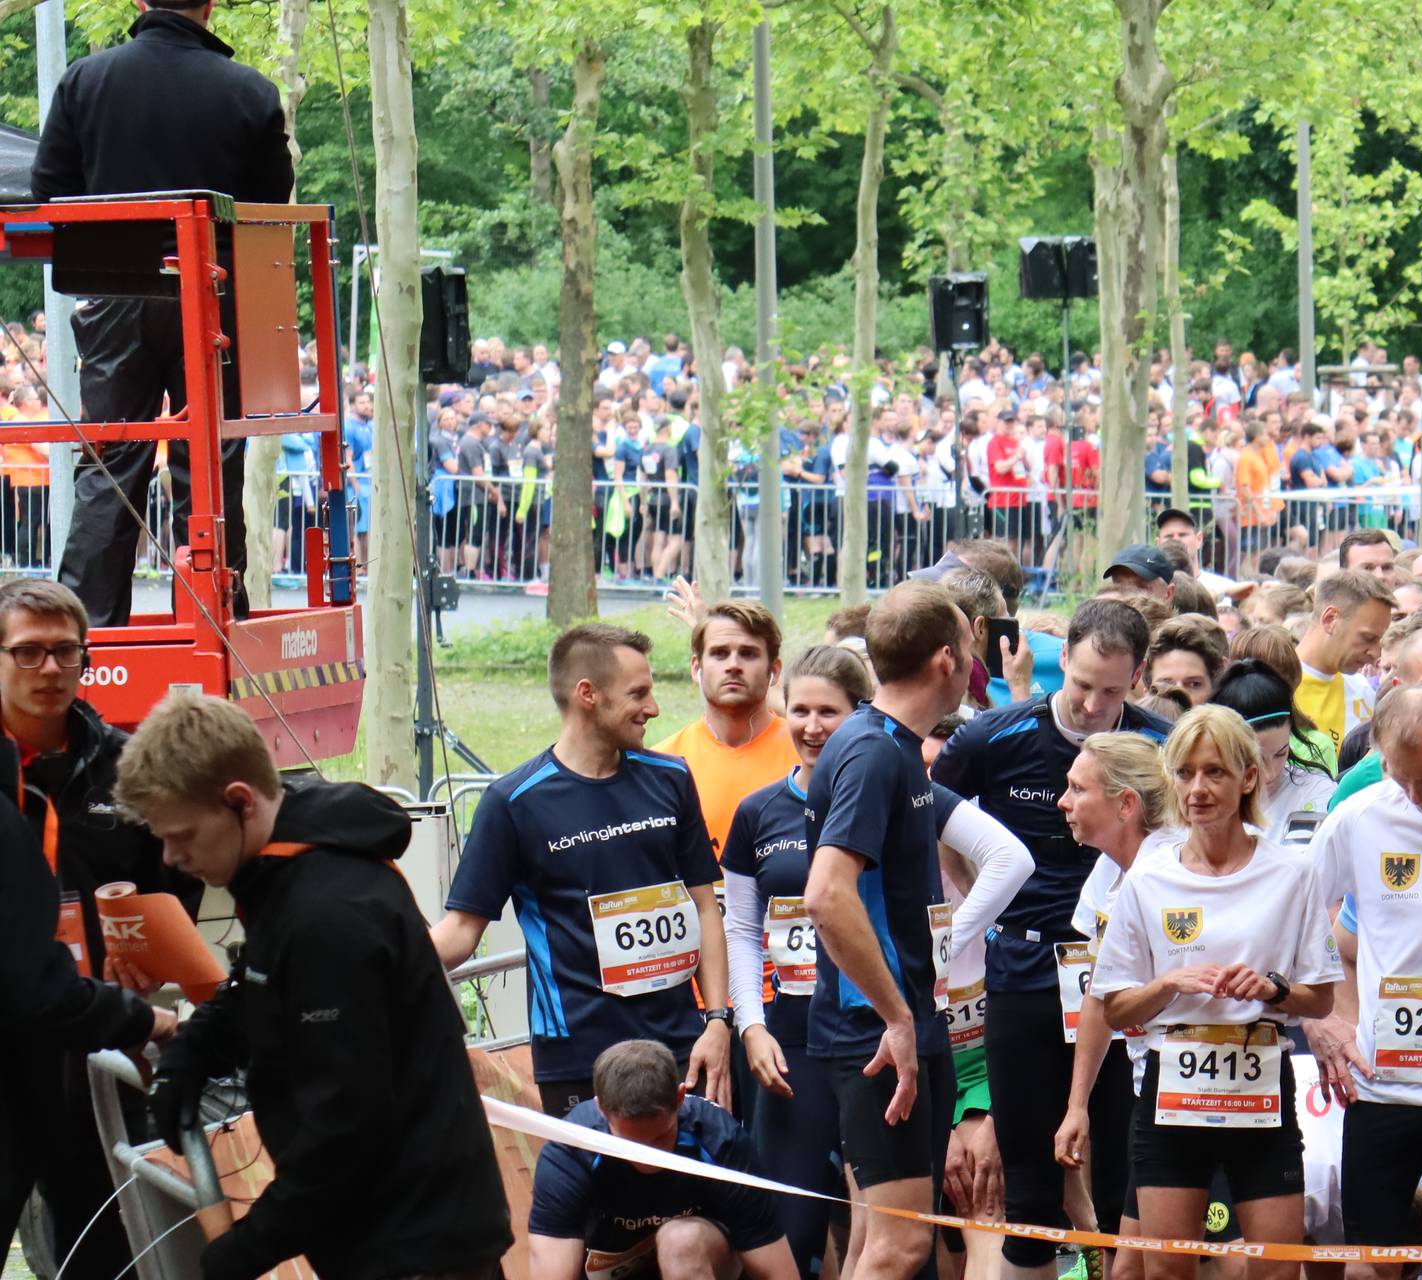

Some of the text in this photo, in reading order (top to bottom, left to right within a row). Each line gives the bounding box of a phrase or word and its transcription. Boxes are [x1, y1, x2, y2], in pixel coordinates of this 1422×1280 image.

[282, 625, 318, 659] mateco
[79, 666, 128, 686] 600
[548, 816, 677, 852] körlinginteriors
[1381, 893, 1419, 901] DORTMUND
[615, 912, 687, 951] 6303
[689, 954, 696, 964] D
[940, 934, 952, 964] 6
[1168, 945, 1206, 956] DORTMUND
[1179, 1050, 1262, 1081] 9413
[1181, 1098, 1222, 1107] STARTZEIT
[1263, 1098, 1272, 1109] D
[1206, 1207, 1225, 1225] BVB
